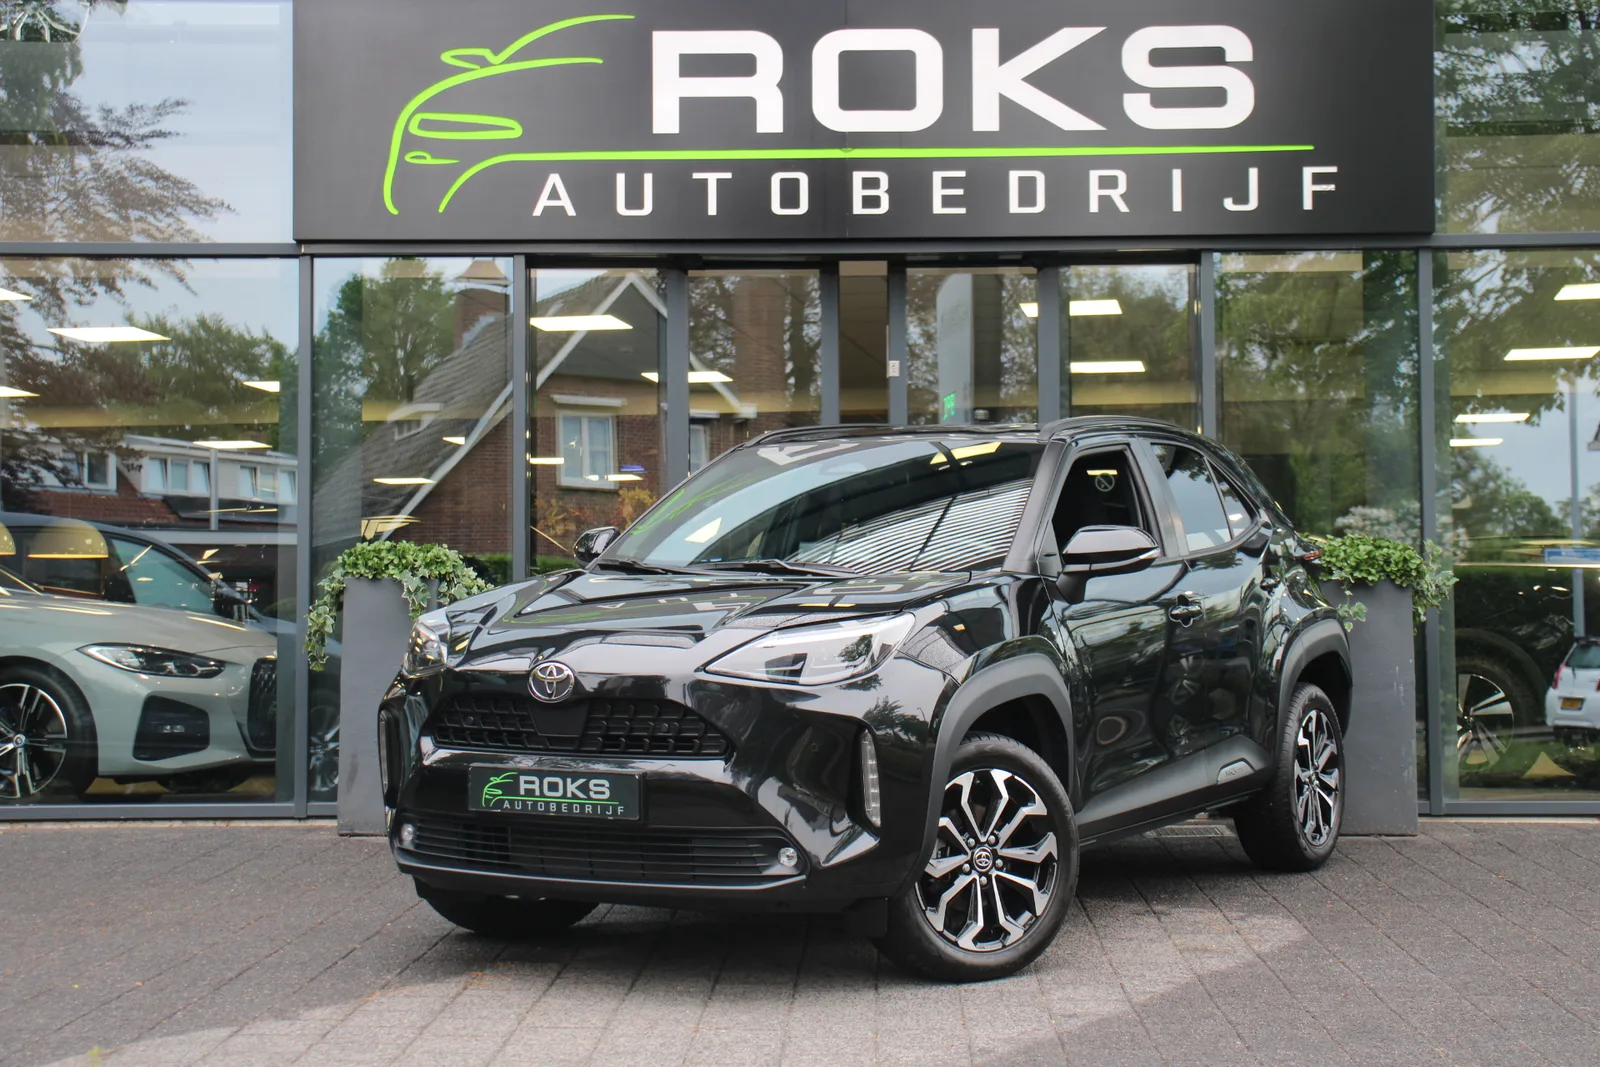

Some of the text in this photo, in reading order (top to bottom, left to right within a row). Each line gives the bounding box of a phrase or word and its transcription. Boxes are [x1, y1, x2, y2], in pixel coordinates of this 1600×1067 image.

[651, 25, 1255, 135] ROKS
[533, 166, 1337, 216] AUTOBEDRIJF
[519, 775, 610, 800] ROKS
[503, 800, 624, 815] AUTOBEDRIJF
